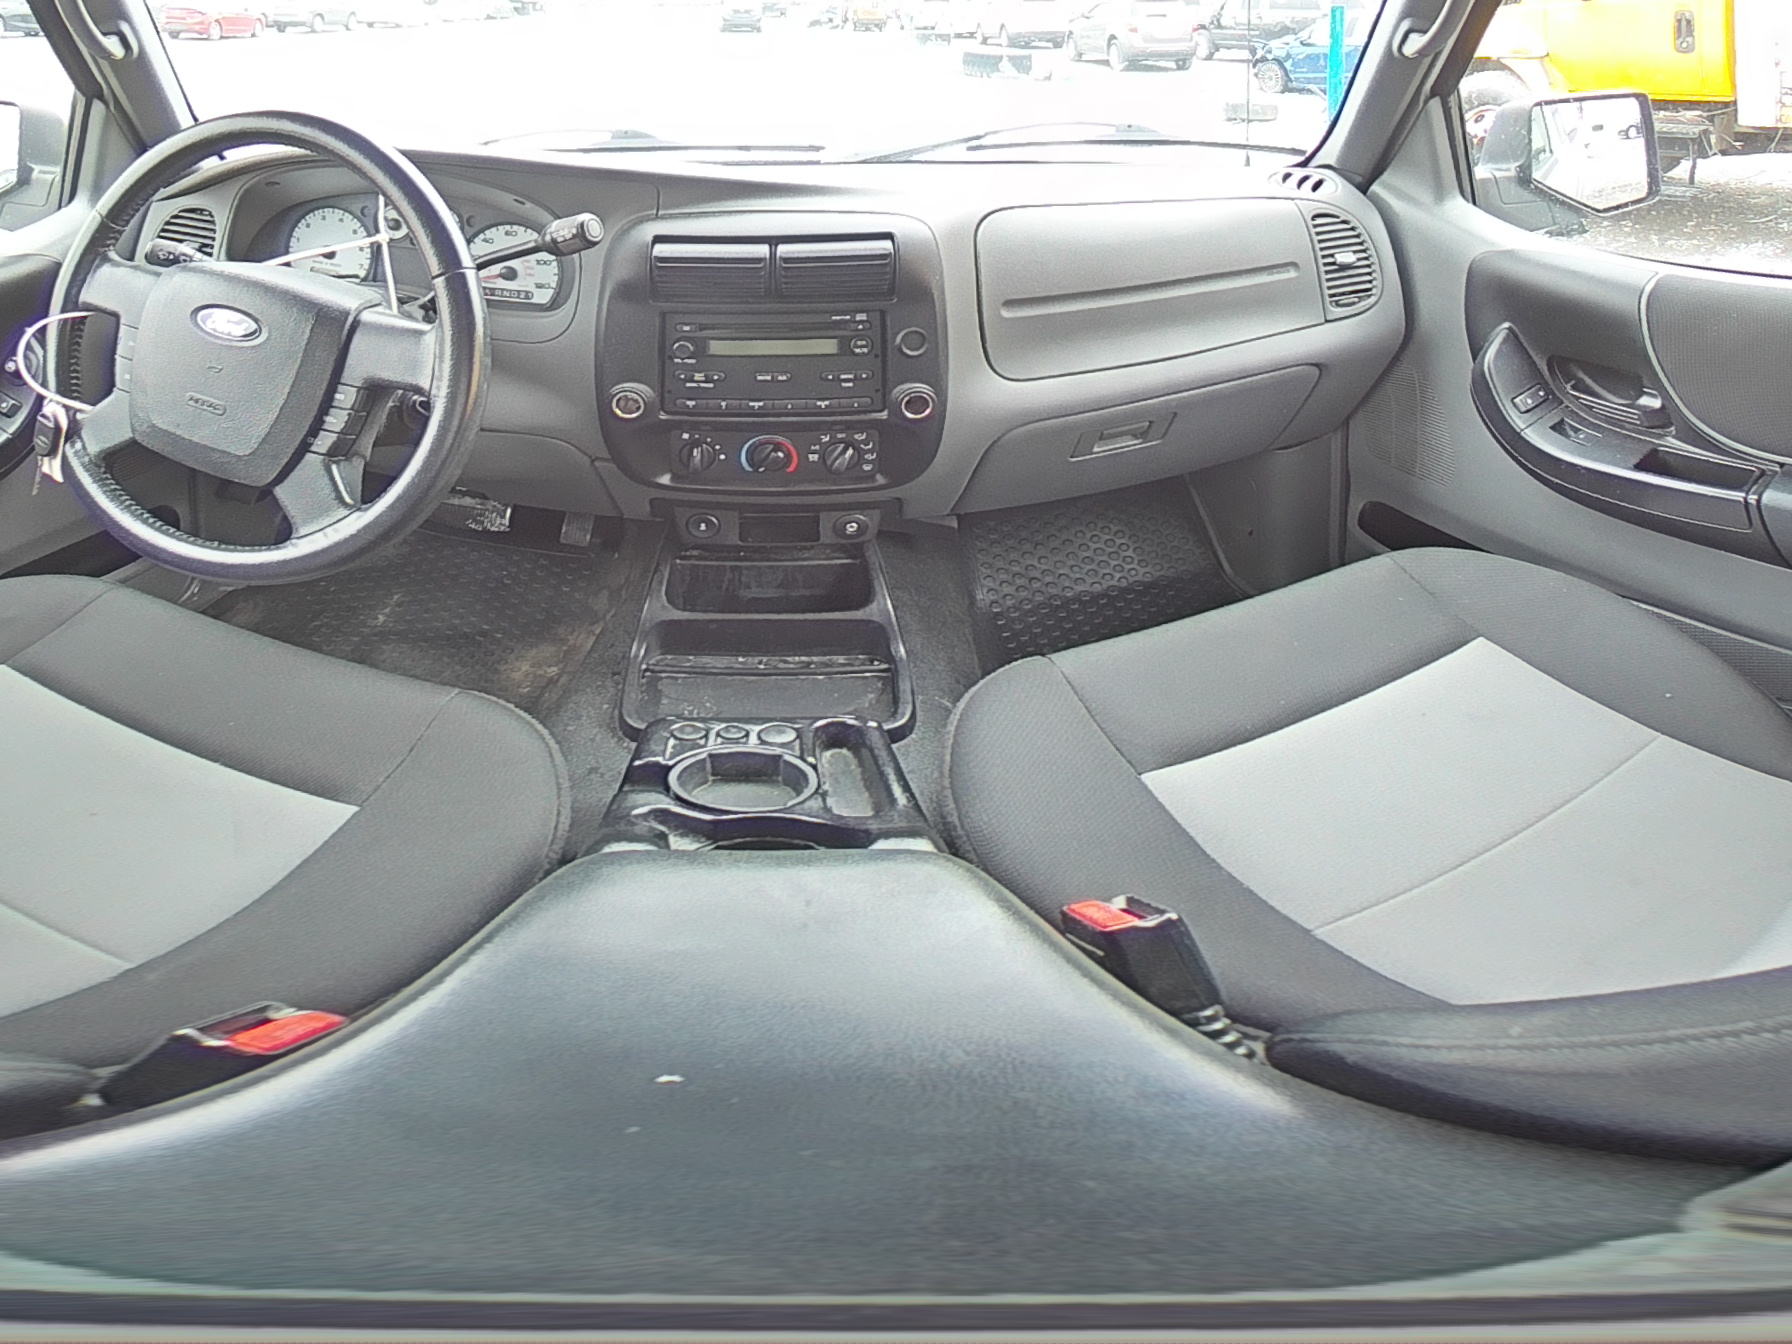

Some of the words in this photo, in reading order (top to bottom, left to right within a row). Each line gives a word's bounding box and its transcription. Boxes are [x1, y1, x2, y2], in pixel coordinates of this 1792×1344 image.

[504, 229, 518, 237] 60
[481, 237, 495, 245] 40
[535, 258, 553, 266] 100
